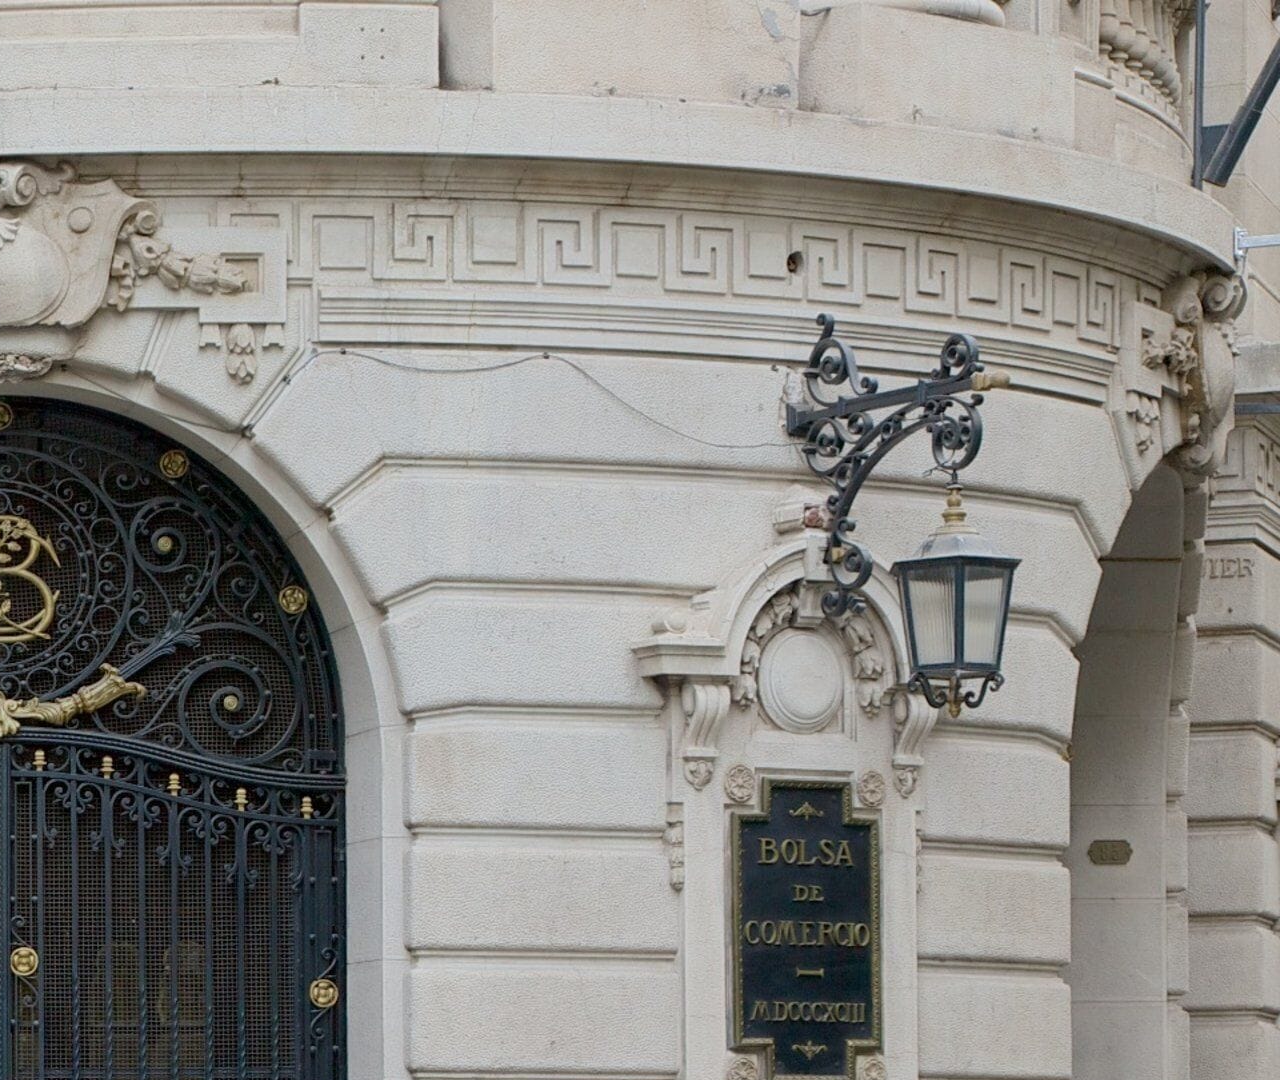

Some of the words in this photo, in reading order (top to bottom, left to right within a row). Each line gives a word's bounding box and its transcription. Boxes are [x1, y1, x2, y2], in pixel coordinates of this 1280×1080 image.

[757, 837, 854, 868] BOLSA
[792, 884, 825, 902] DE
[743, 920, 870, 947] COMERCIO
[750, 1000, 866, 1023] MDCCCXCIII
